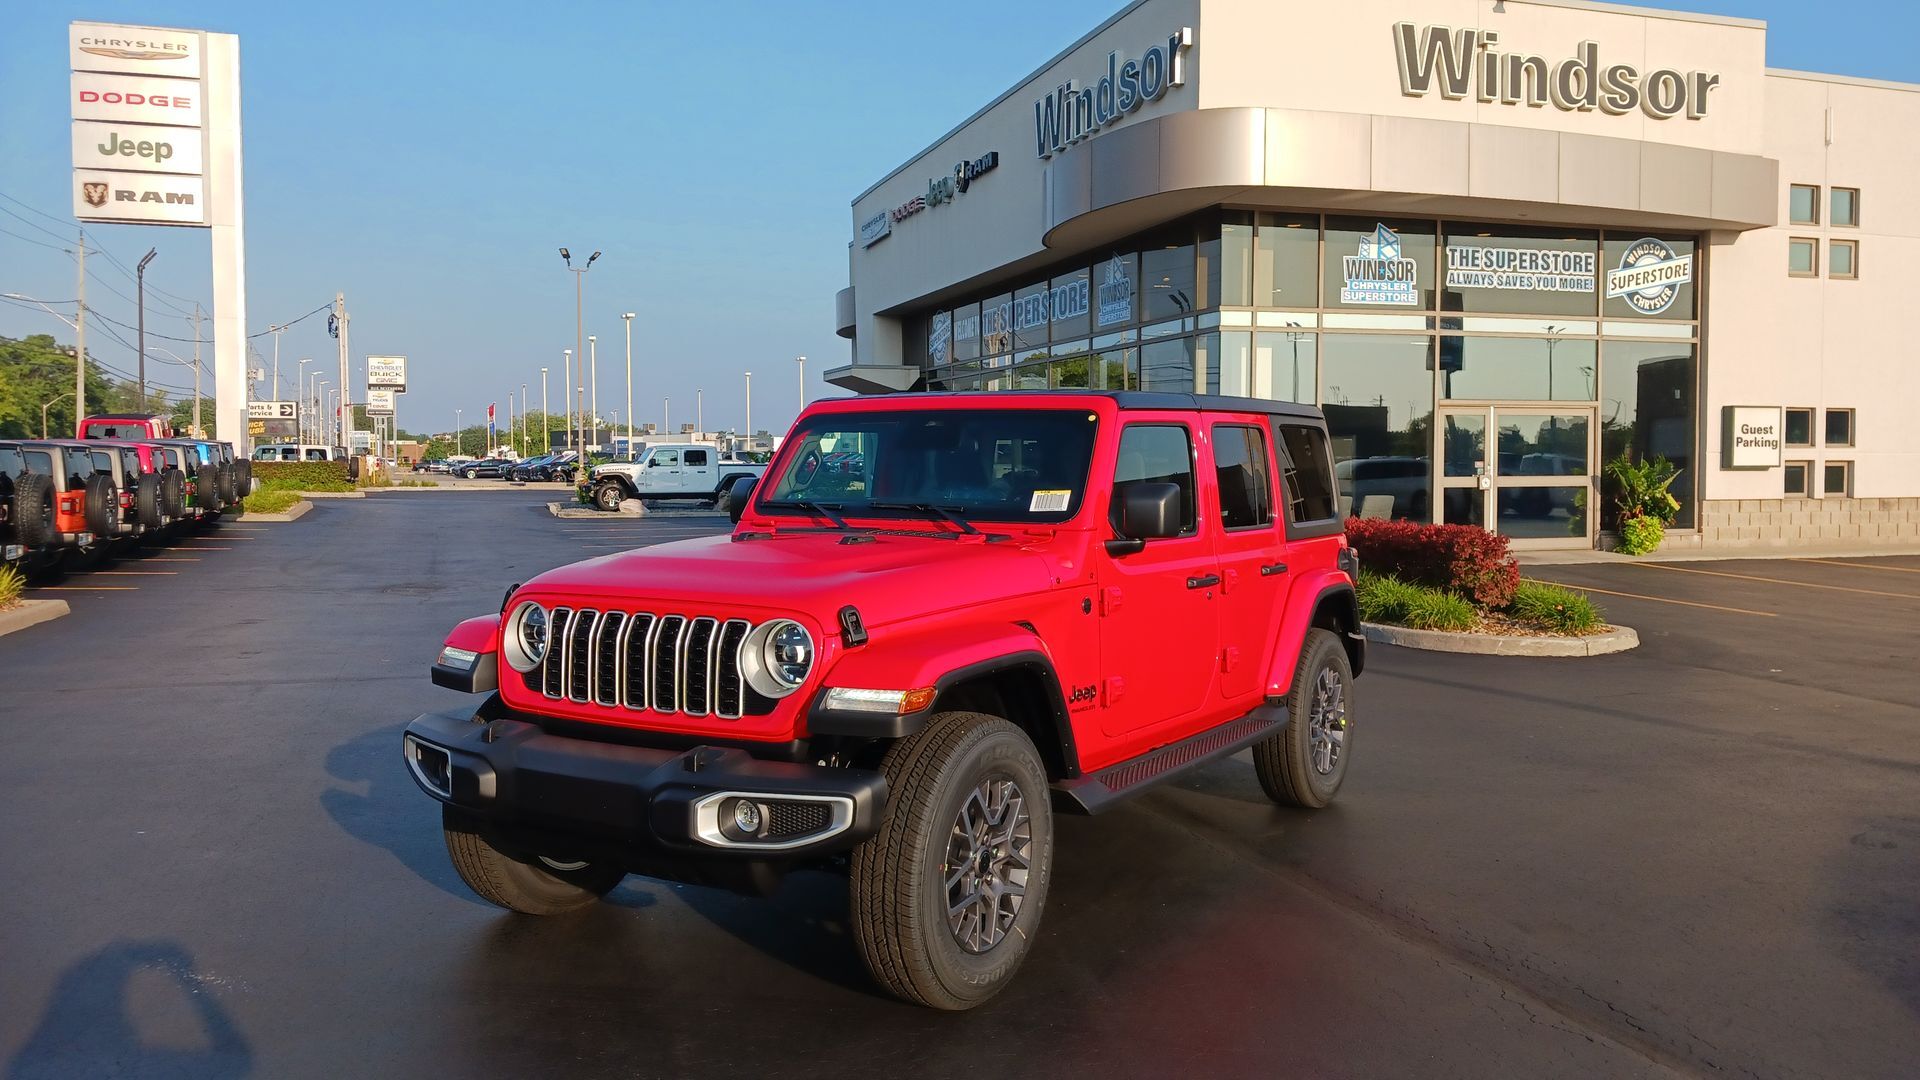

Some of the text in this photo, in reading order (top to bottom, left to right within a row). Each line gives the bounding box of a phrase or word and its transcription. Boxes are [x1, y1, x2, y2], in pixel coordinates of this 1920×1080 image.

[80, 37, 188, 51] CHRYSLER
[1393, 21, 1720, 119] Windsor
[79, 91, 191, 108] DODGE
[1034, 27, 1191, 158] Windsor
[98, 132, 173, 163] Jeep
[965, 152, 997, 180] RAM
[114, 189, 194, 205] RAM
[925, 177, 953, 207] Jeep
[892, 196, 926, 222] DODGE
[861, 212, 886, 232] CHRYSLER
[1449, 248, 1593, 272] THE SUPERSTORE
[1627, 244, 1667, 264] WINDSOR
[1346, 259, 1414, 281] WINDSOR
[1611, 263, 1689, 291] SUPERSTORE
[1352, 281, 1408, 291] CHRYSLER
[1448, 272, 1593, 290] ALWAYS SAVES YOU MORE!
[1000, 280, 1089, 333] SUPERSTORE
[1344, 291, 1416, 302] SUPERSTORE
[1633, 287, 1673, 310] CHRYSLER
[1741, 424, 1773, 434] Guest
[1736, 437, 1778, 449] Parking
[1069, 684, 1097, 704] Jeep
